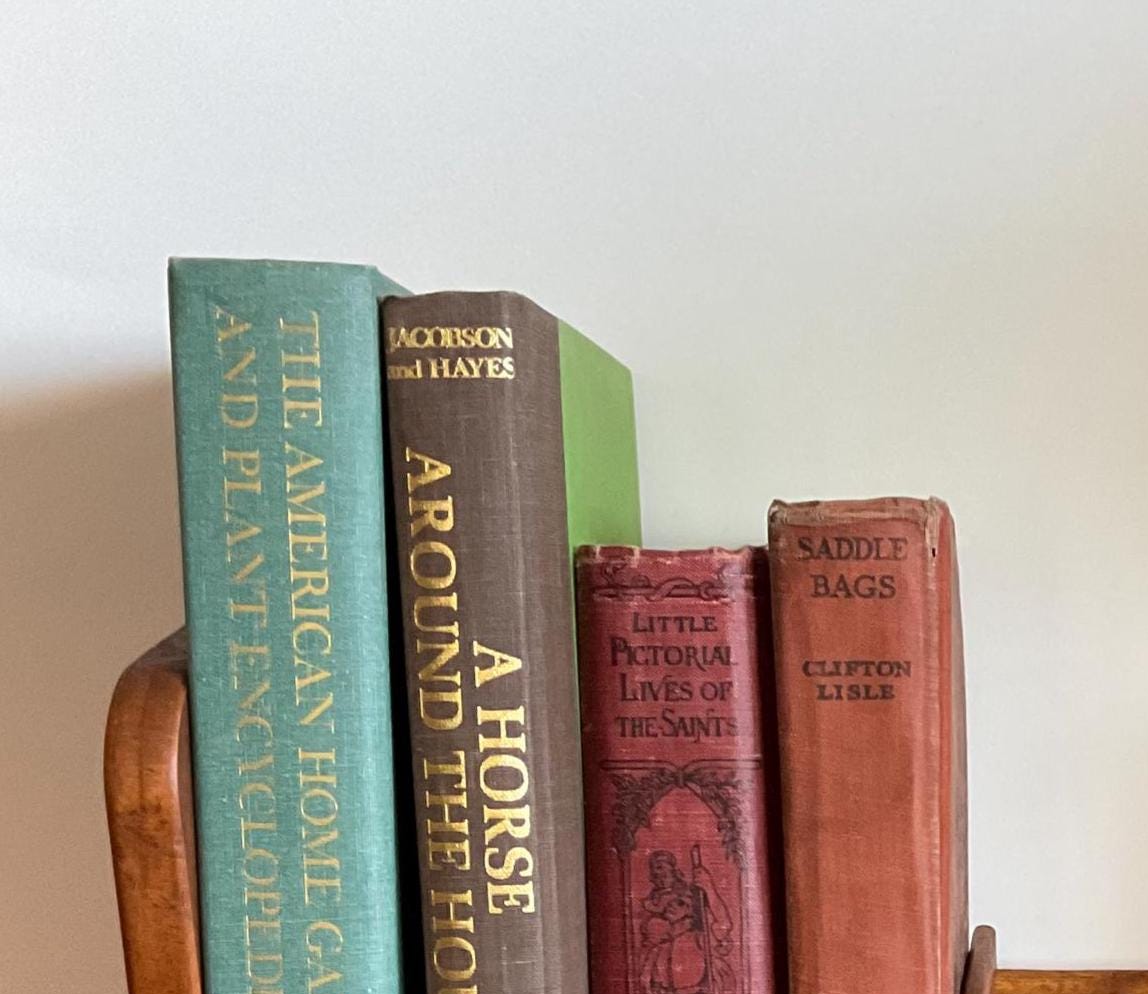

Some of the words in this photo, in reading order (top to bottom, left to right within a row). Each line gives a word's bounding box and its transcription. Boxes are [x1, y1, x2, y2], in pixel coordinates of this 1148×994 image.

[387, 326, 514, 352] JACOBSON
[213, 305, 259, 430] AND
[280, 310, 322, 430] THE
[386, 358, 423, 379] and
[429, 356, 516, 379] HAYES
[222, 448, 266, 630] PLANT
[797, 536, 908, 561] SADDLE
[284, 441, 335, 734] AMERICAN
[405, 446, 463, 732] AROUND
[810, 573, 896, 599] BAGS
[632, 611, 718, 633] LITTLE
[472, 640, 523, 689] A
[610, 635, 738, 672] PICTORIAL
[802, 659, 911, 678] CLIFTON
[620, 673, 694, 701] LIVES
[700, 681, 734, 701] OF
[816, 684, 896, 701] LISLE
[299, 747, 341, 906] HOME
[423, 749, 471, 872] THE
[476, 705, 535, 915] HORSE
